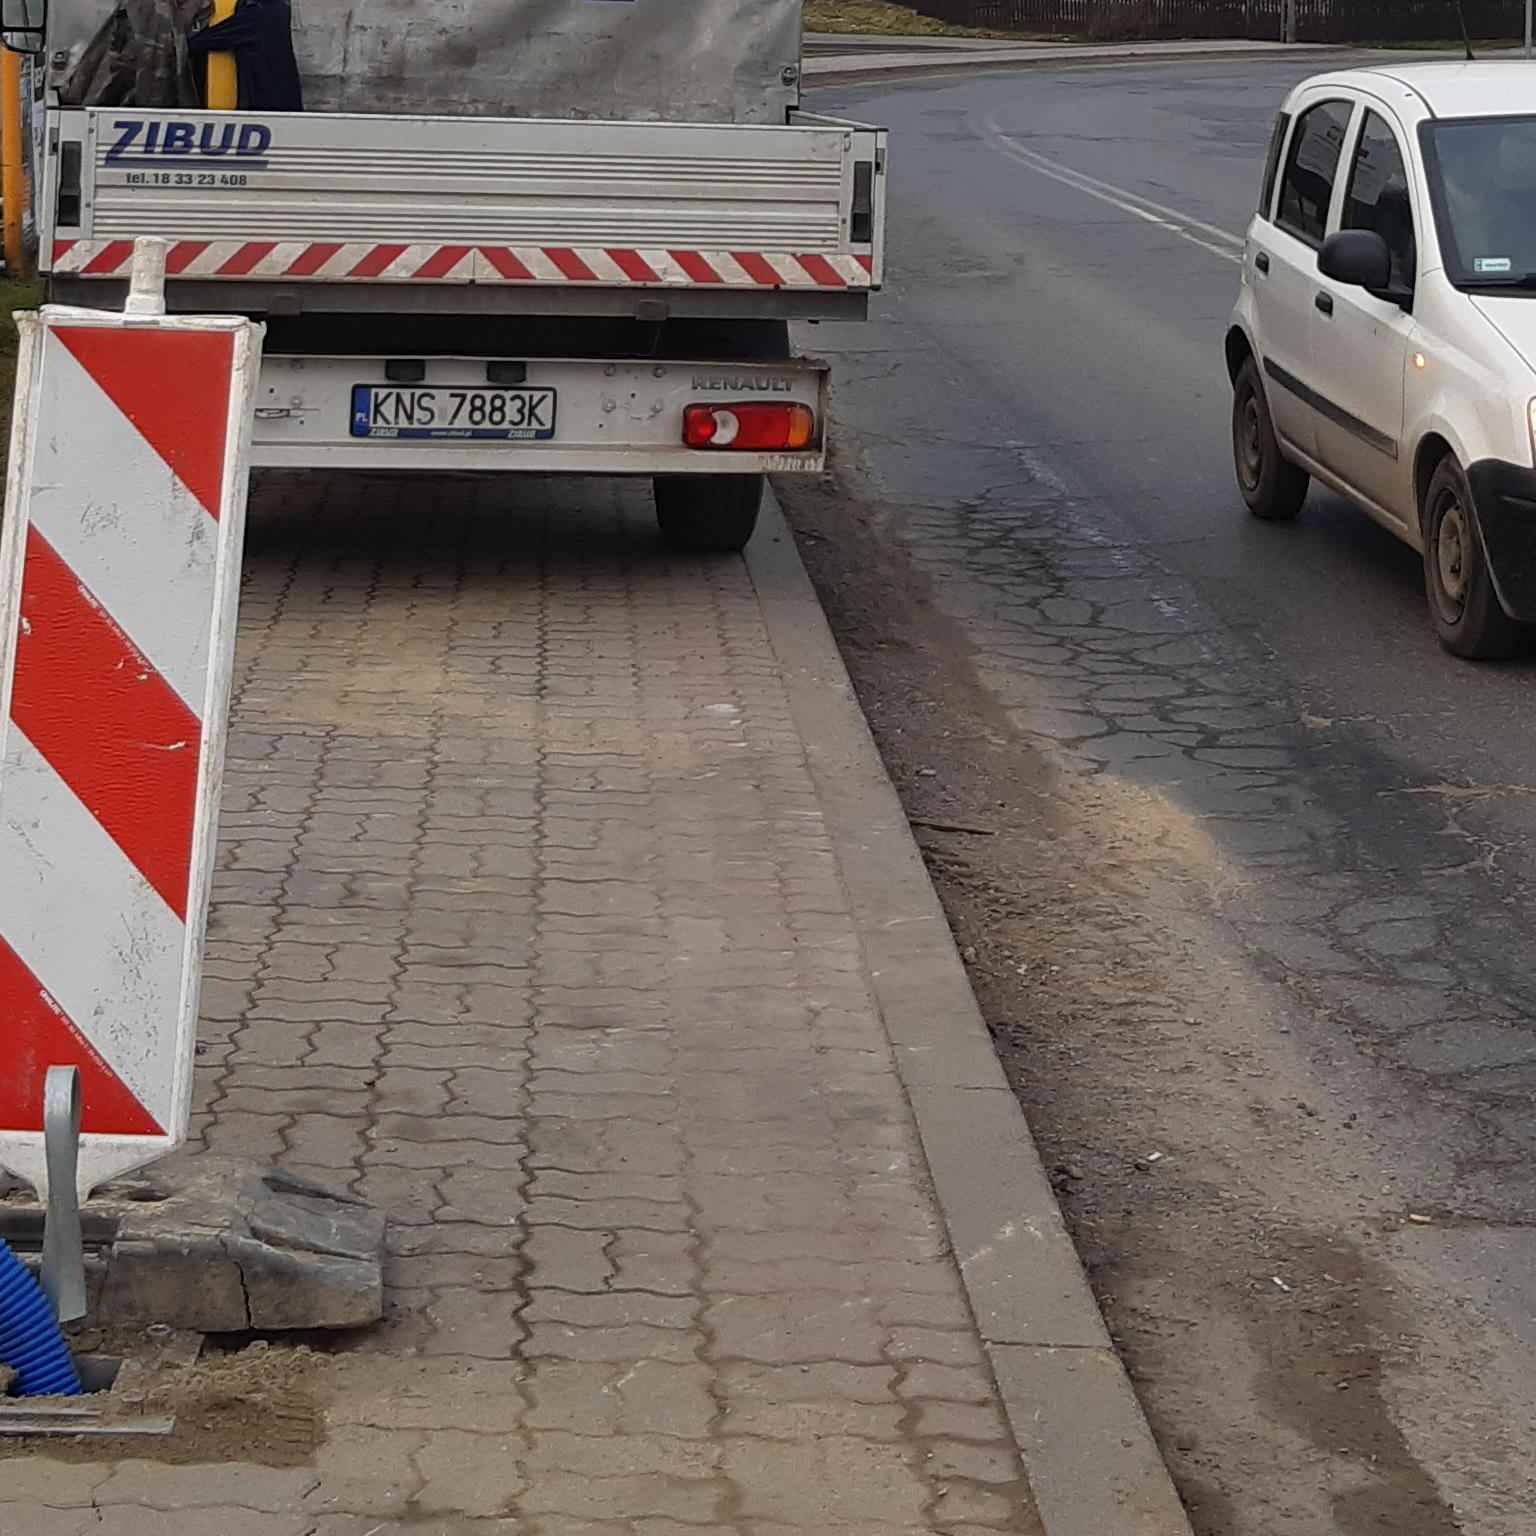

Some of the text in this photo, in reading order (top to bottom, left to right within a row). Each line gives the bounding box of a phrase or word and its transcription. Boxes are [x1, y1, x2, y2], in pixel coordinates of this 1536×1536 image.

[104, 120, 272, 166] ZIBUD
[126, 172, 247, 186] tel. 18 33 23 408
[372, 391, 549, 427] KNS 7883K
